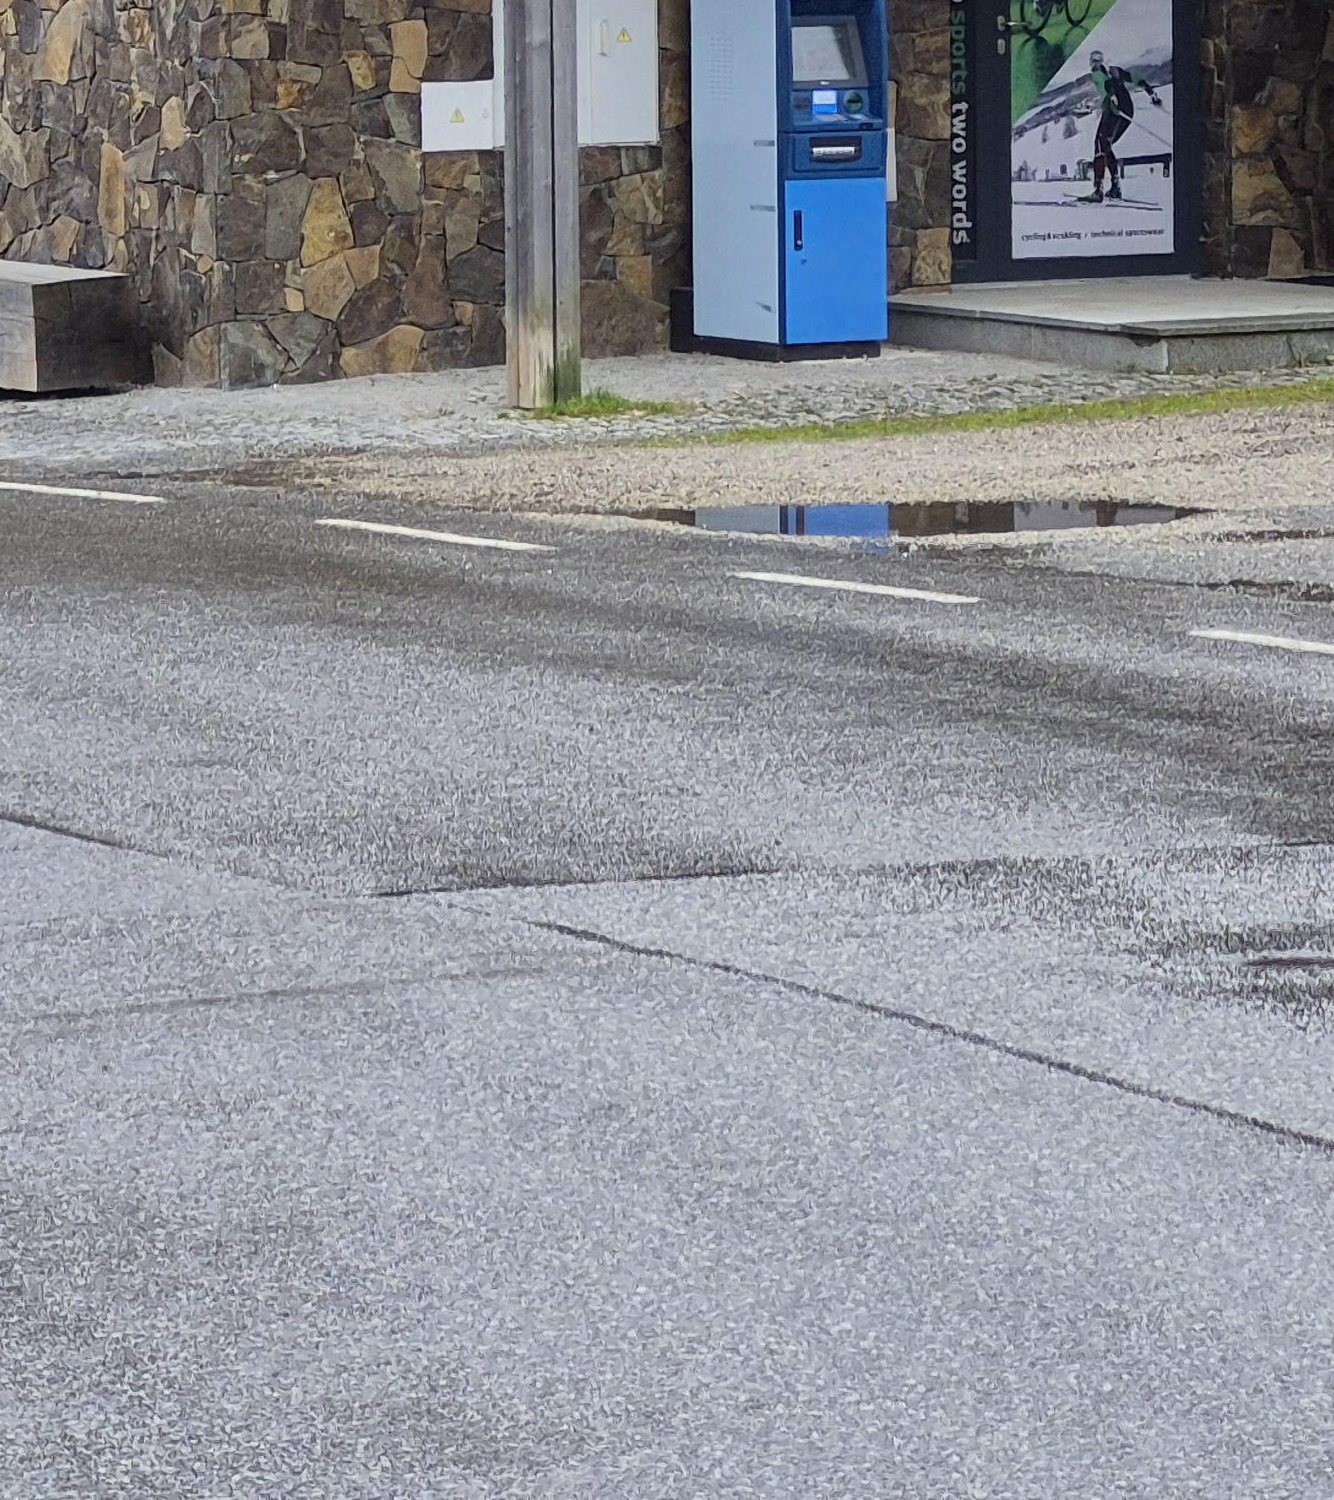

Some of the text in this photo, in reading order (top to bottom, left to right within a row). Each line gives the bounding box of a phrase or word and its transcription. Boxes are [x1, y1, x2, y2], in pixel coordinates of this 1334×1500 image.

[951, 9, 968, 96] sports
[951, 101, 969, 154] two
[951, 160, 973, 246] words
